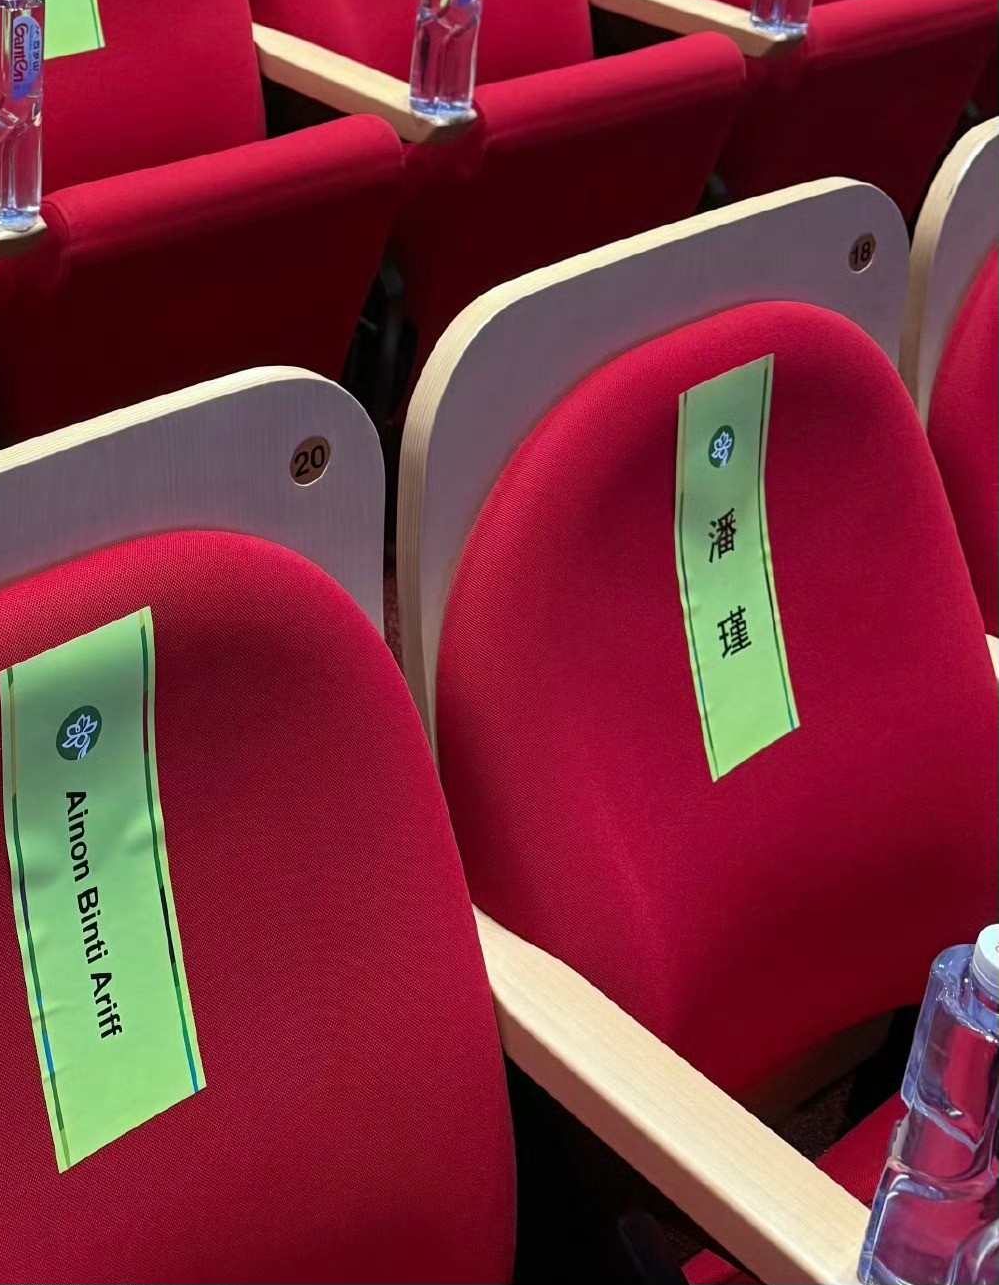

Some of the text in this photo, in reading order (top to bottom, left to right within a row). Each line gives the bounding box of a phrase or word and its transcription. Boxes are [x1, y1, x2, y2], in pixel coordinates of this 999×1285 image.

[850, 240, 871, 264] 18
[292, 444, 327, 478] 20
[708, 507, 752, 659] 潘瑾
[65, 791, 123, 1039] Ainon Binti Ariff
